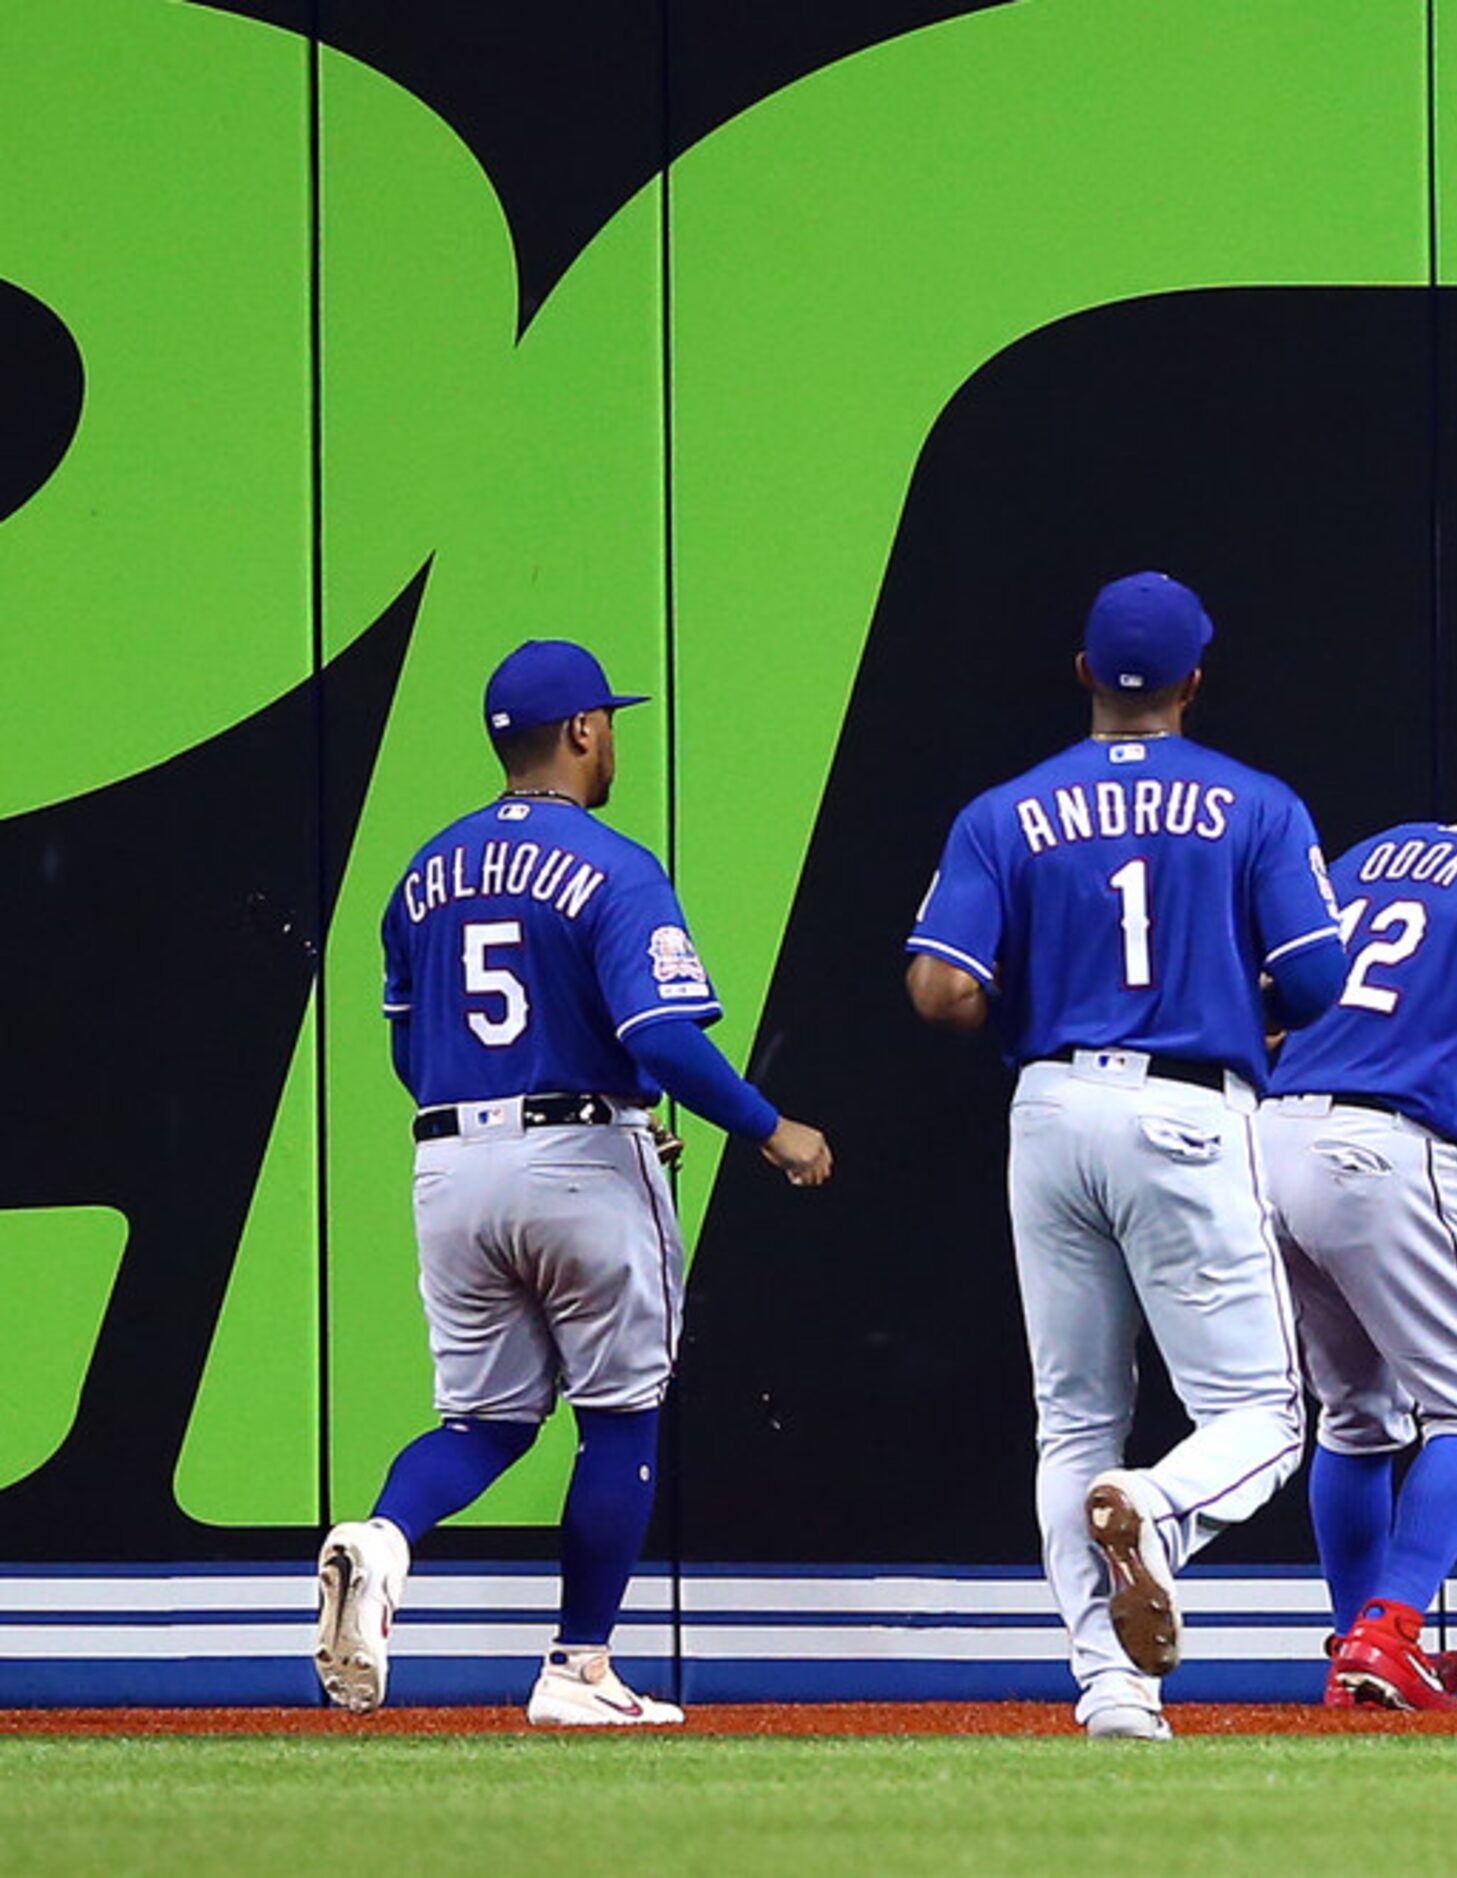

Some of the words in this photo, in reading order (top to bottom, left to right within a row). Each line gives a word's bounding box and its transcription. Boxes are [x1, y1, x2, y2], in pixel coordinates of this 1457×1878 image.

[1016, 779, 1235, 853] ANDRUS
[403, 840, 605, 924] CALHOUN
[1110, 859, 1150, 987] 1
[462, 921, 530, 1046] 5
